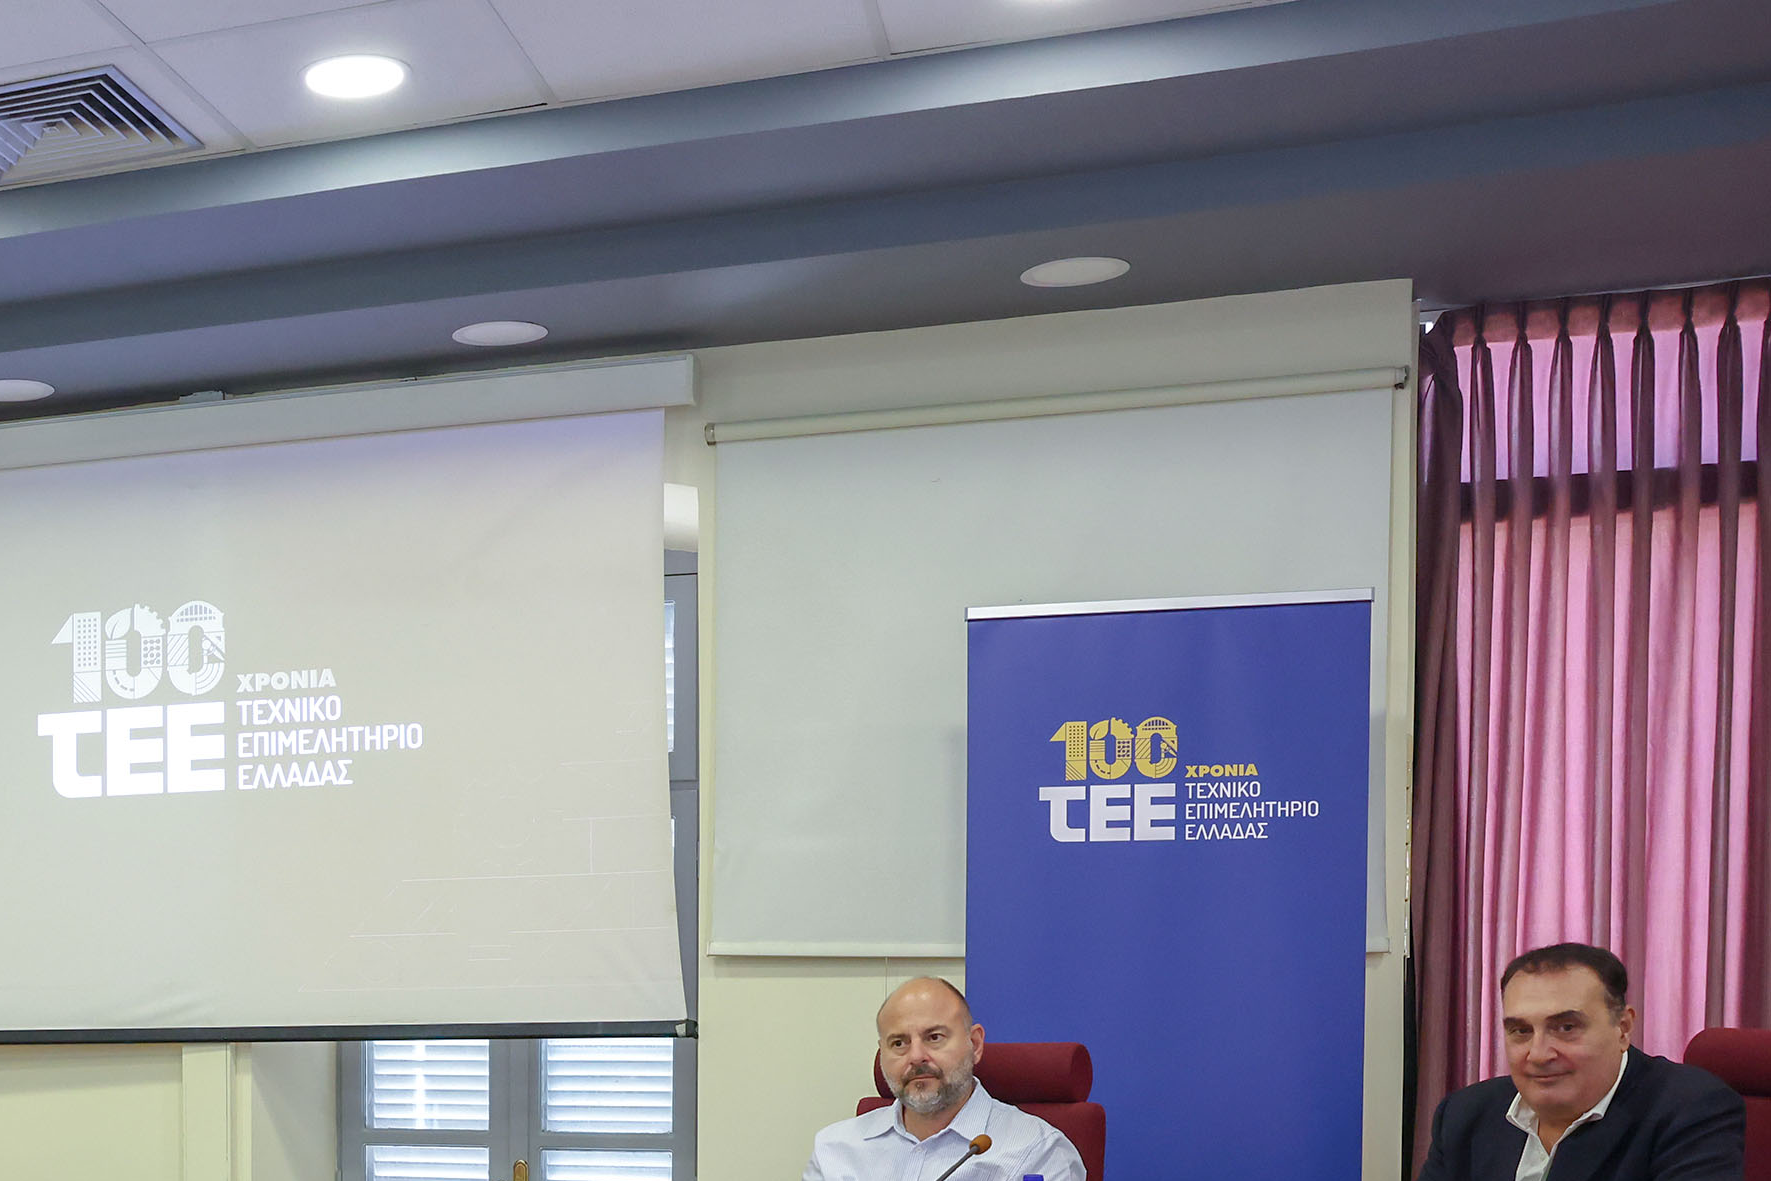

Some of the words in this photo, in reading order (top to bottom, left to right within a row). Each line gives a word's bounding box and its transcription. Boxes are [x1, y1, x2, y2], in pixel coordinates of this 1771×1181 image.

[51, 600, 226, 703] 100
[236, 668, 336, 693] ΧΡΟΝΙΑ
[236, 695, 342, 726] ΤΕΧΝΙΚΟ
[237, 722, 422, 758] ΕΠΙΜΕΛΗΤΗΡΙΟ
[1049, 716, 1177, 781] 100
[237, 760, 353, 790] ΕΛΛΑΔΑΣ
[1185, 763, 1258, 778] ΧΡΟΝΙΑ
[1185, 781, 1261, 799] ΤΕΧΝΙΚΟ
[1185, 801, 1319, 820] ΕΠΙΜΕΛΗΤΗΡΙΟ
[1185, 823, 1269, 840] ΕΛΛΑΔΑΣ
